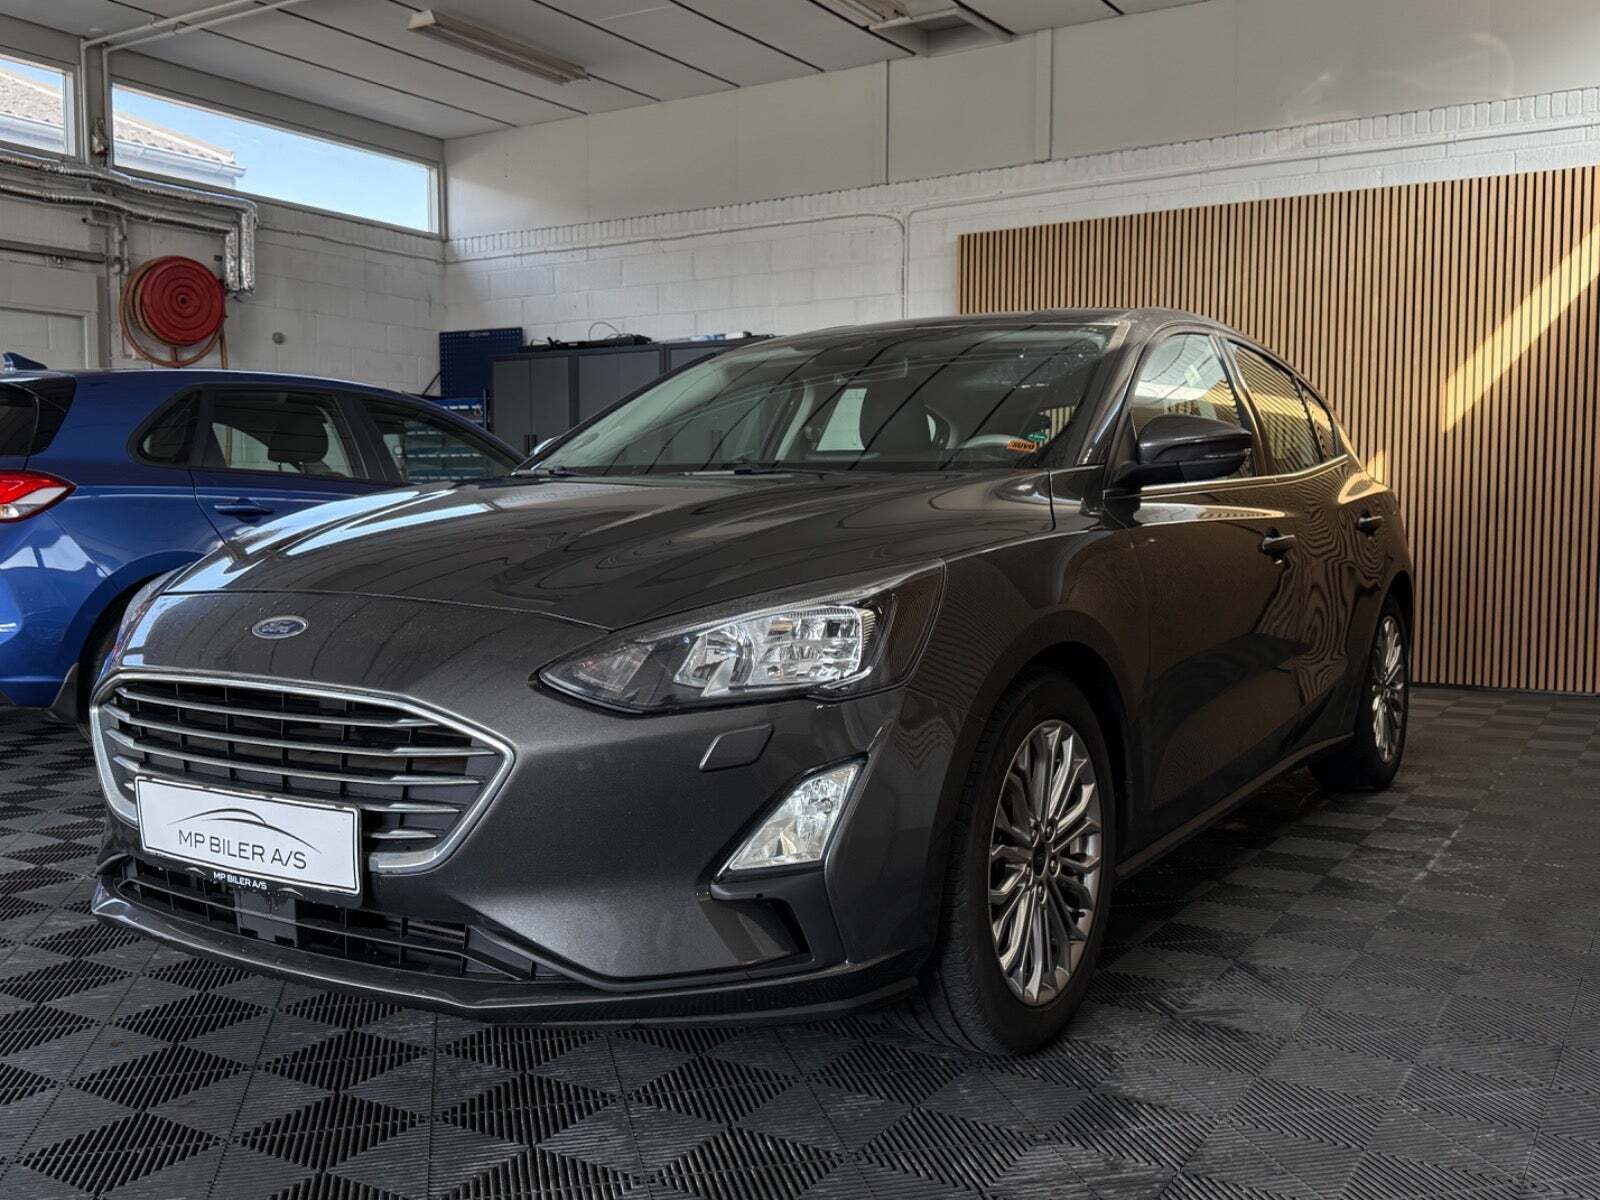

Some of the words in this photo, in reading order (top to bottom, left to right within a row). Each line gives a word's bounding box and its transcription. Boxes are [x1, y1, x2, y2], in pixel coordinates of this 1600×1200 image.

[178, 829, 206, 848] MP
[209, 835, 265, 863] BILER
[270, 848, 307, 870] A/S
[213, 871, 226, 881] MP
[227, 874, 252, 887] BILER
[251, 881, 268, 891] A/S
